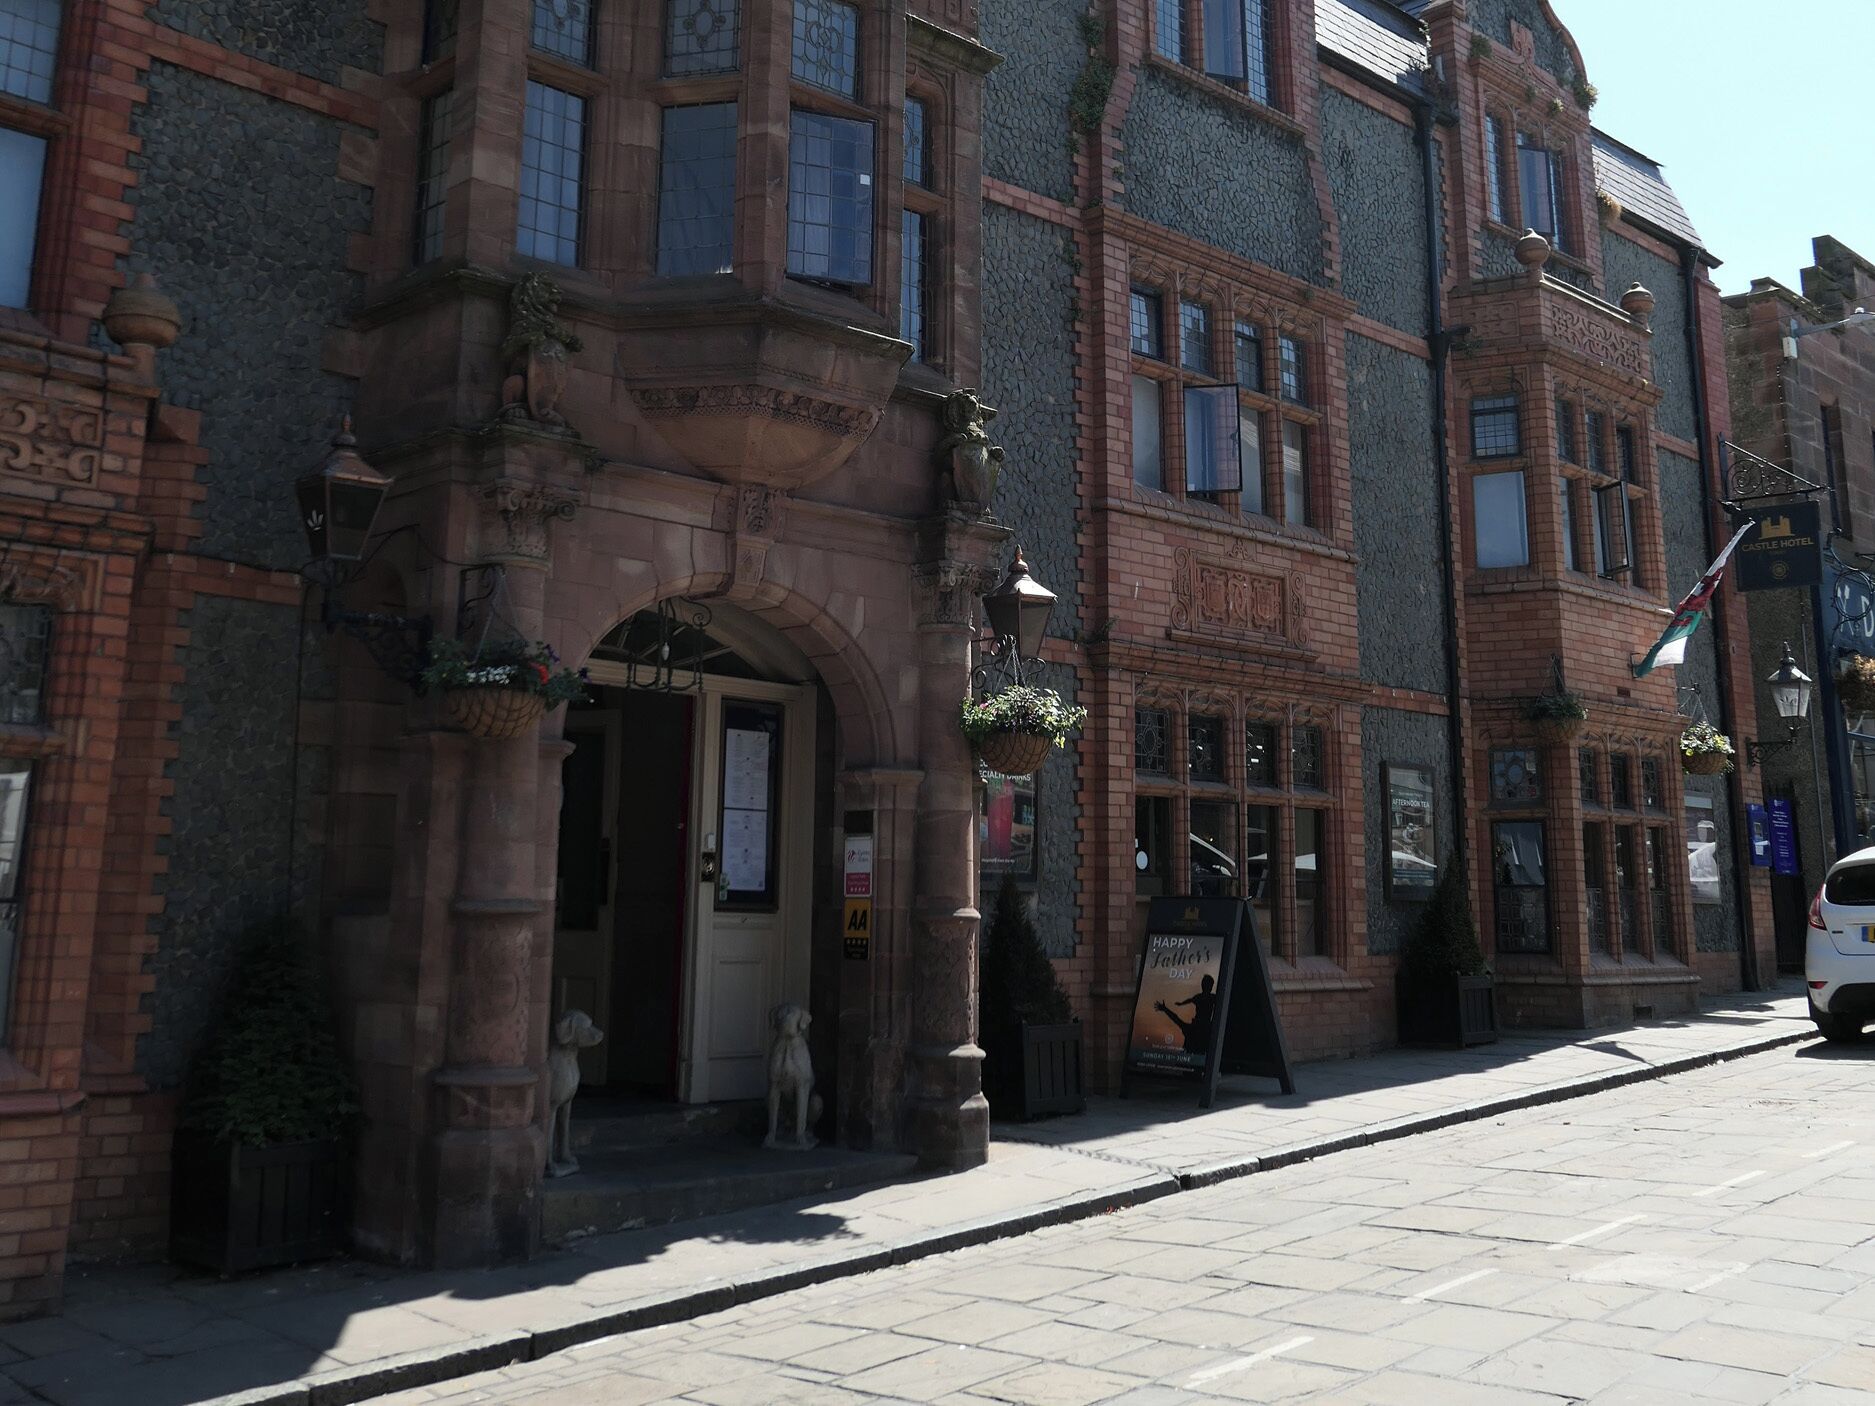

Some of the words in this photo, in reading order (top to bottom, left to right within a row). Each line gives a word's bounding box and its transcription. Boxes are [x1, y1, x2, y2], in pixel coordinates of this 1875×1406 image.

[1741, 539, 1778, 552] CASTLE
[1780, 537, 1815, 548] HOTEL
[1391, 798, 1421, 808] AFTERNOON
[1421, 800, 1430, 809] TEA
[847, 909, 868, 931] AA
[1152, 936, 1194, 950] HAPPY
[1150, 946, 1211, 969] Father's
[1168, 967, 1193, 980] DAY
[1142, 1051, 1165, 1060] SUNDAY
[1176, 1055, 1191, 1063] JUNE
